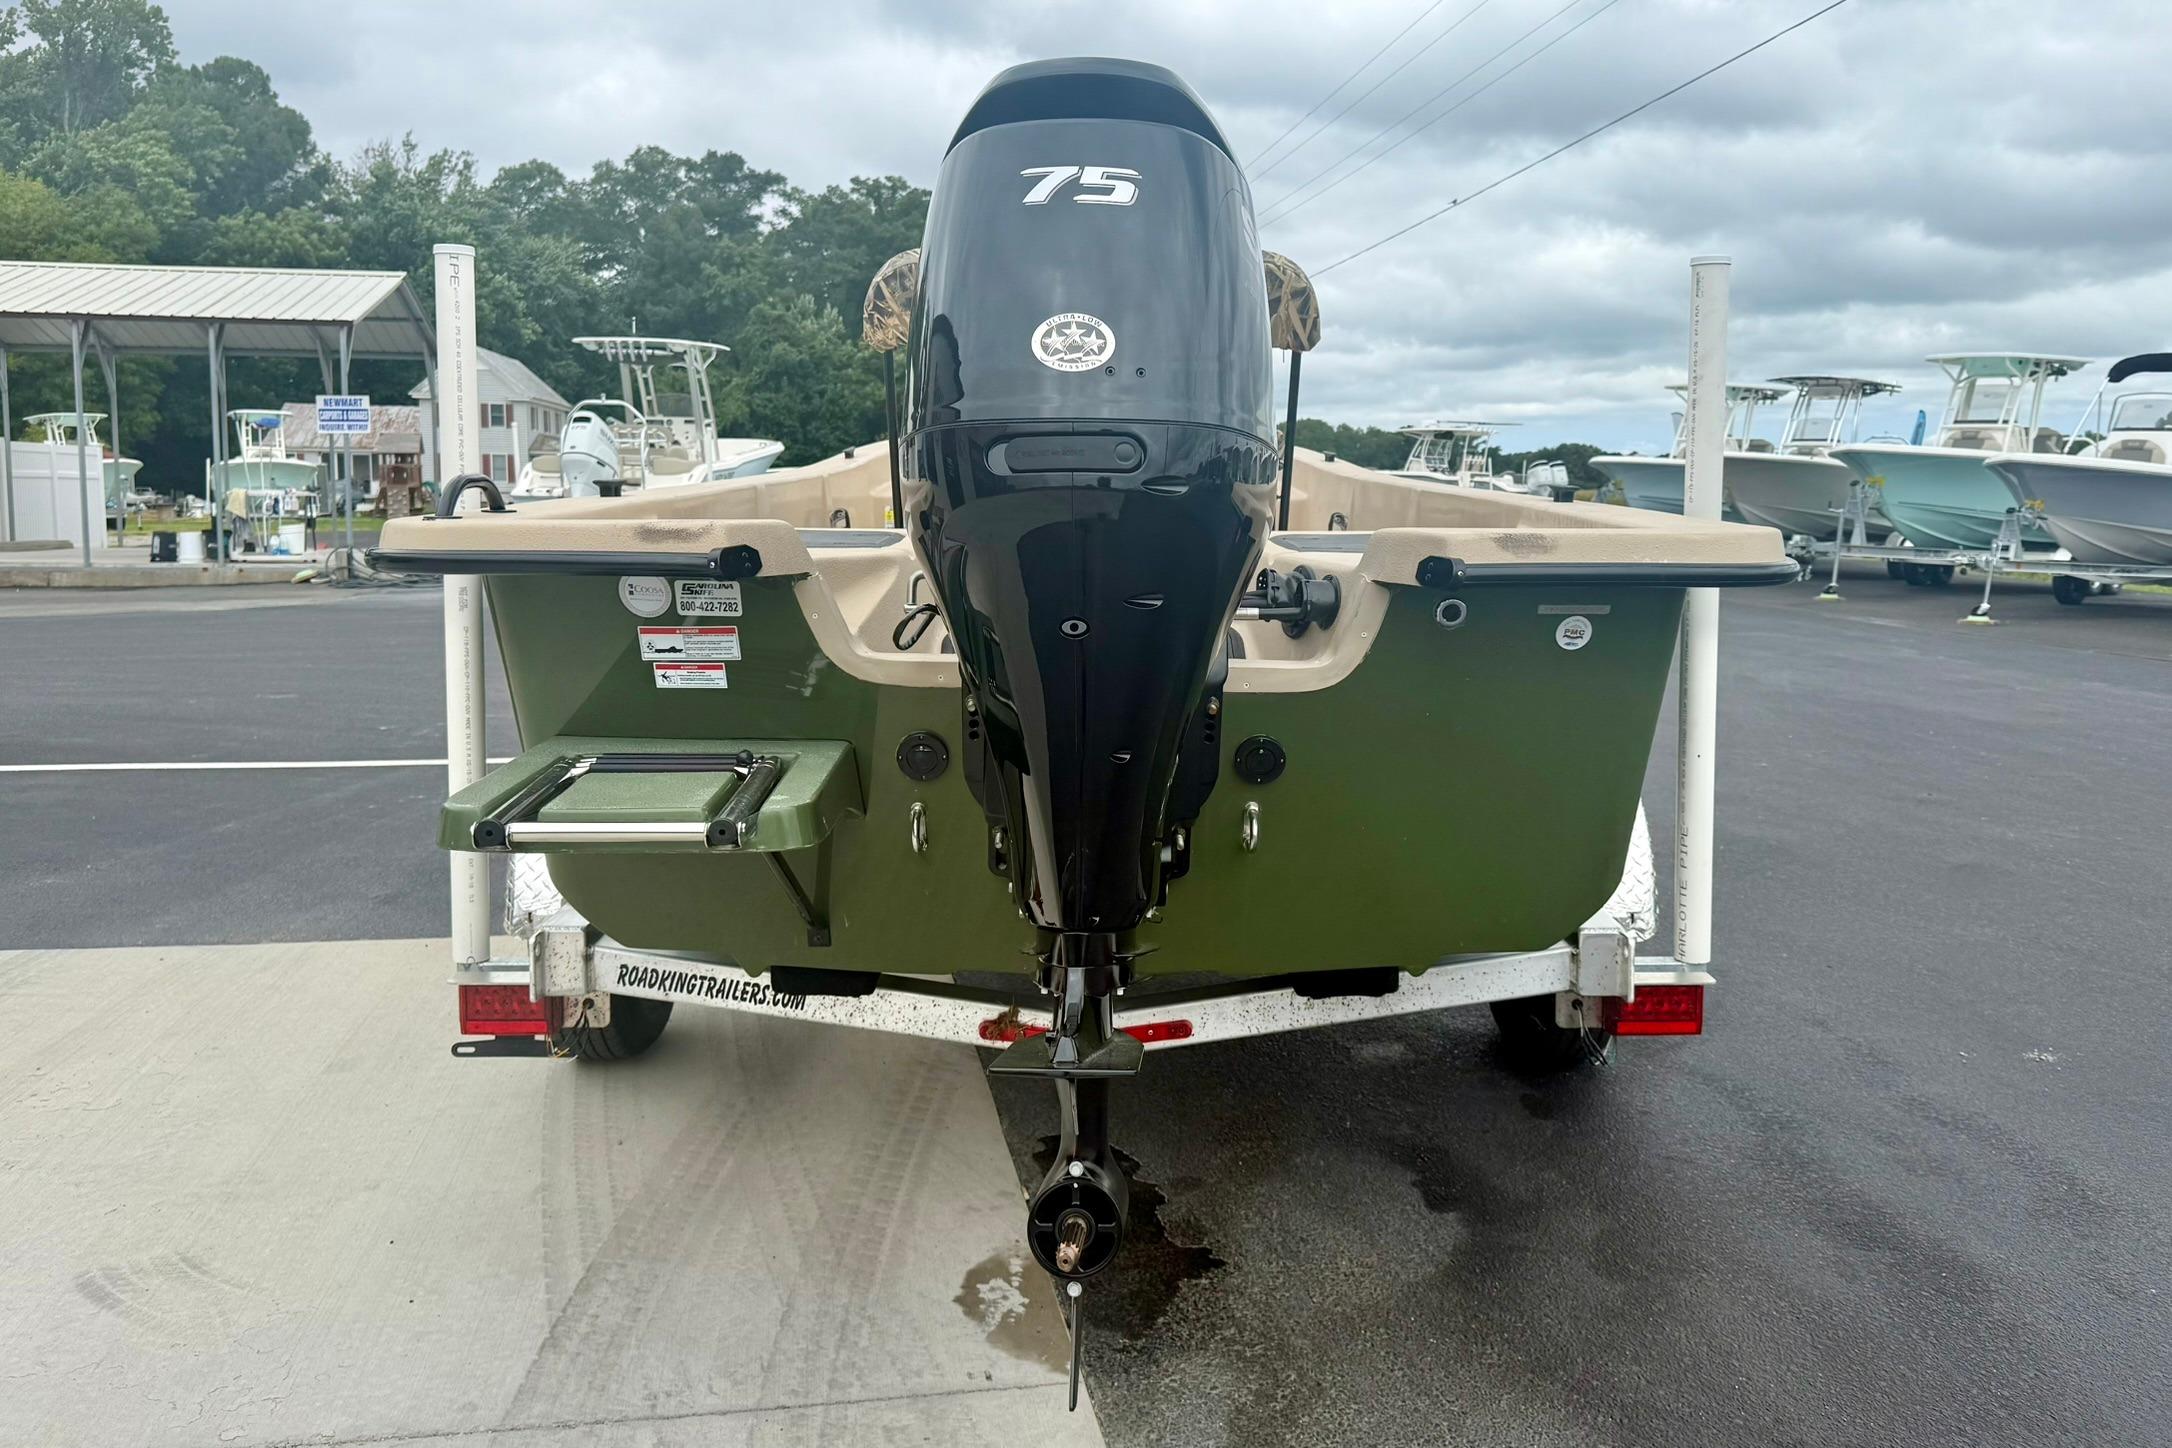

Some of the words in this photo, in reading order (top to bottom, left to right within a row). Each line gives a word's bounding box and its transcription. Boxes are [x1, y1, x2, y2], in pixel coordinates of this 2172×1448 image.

[1020, 165, 1143, 206] 75
[323, 398, 363, 407] NEWMART
[680, 601, 739, 613] 800-422-7282
[1678, 825, 1689, 869] PIPE
[617, 963, 807, 1011] ROADKINGTRAILERS.COM
